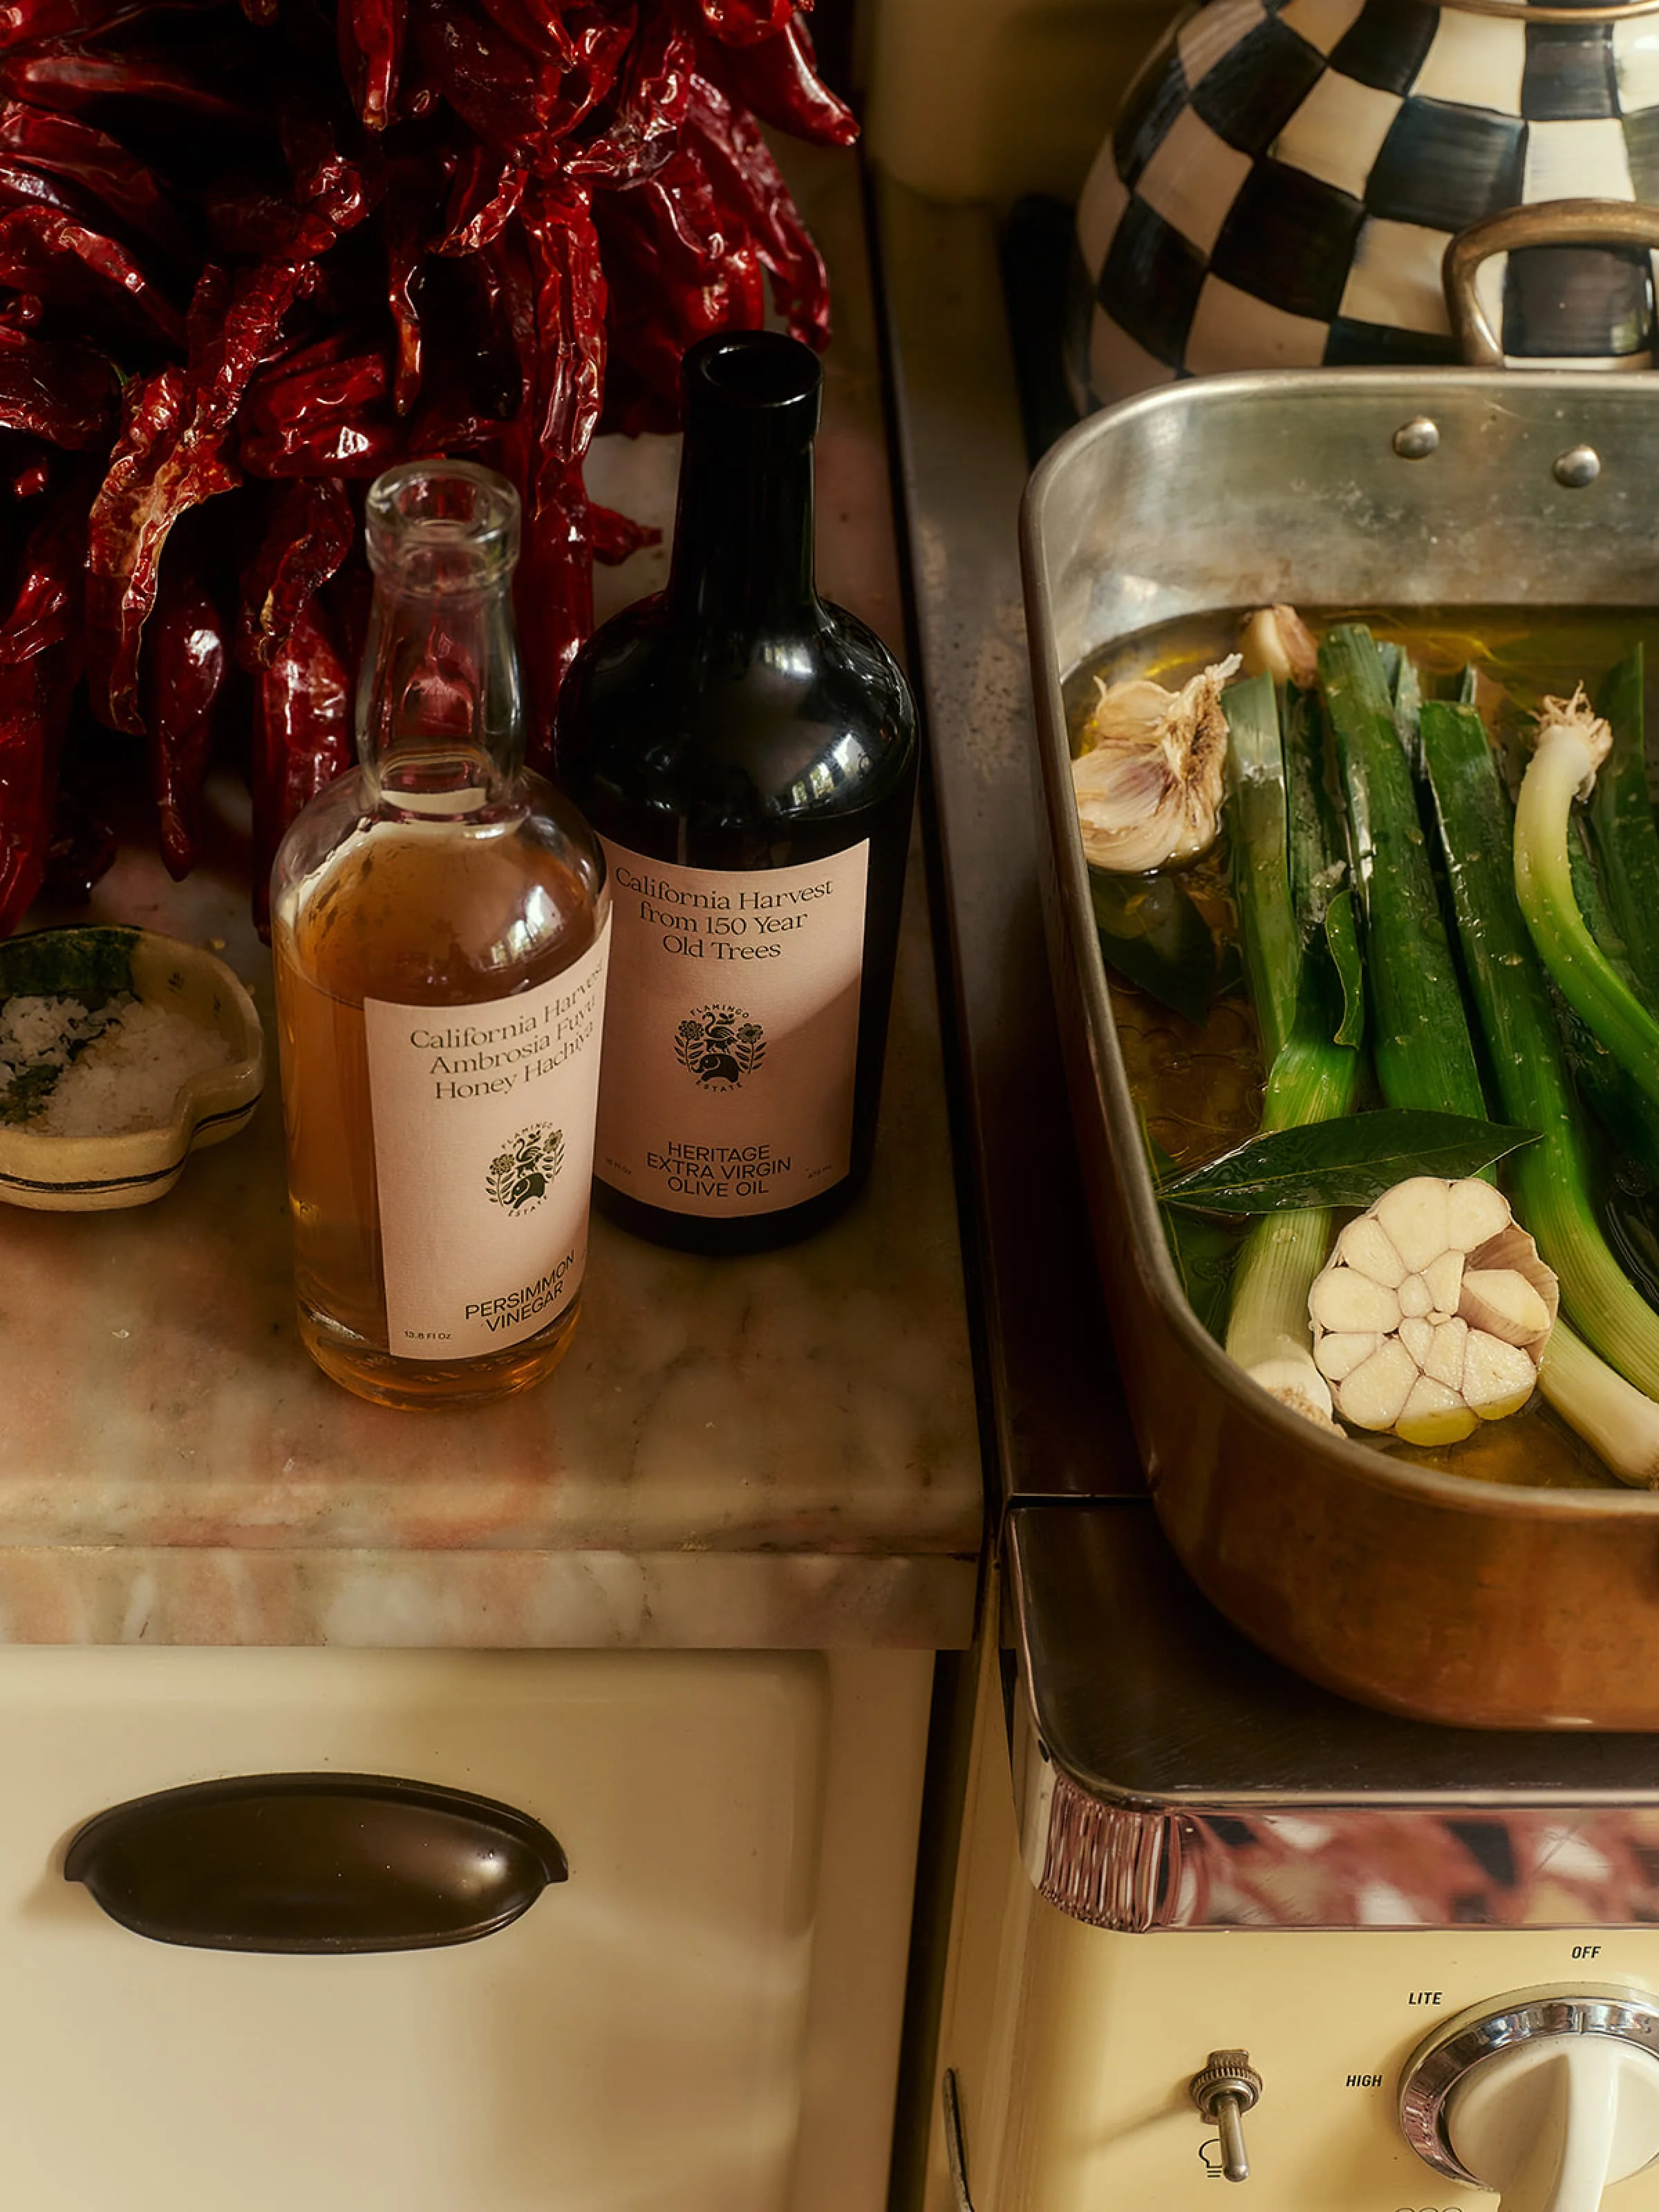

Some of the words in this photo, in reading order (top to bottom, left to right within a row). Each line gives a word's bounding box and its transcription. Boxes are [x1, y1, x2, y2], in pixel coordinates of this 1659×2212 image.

[616, 868, 731, 910] California
[739, 880, 834, 910] Harvest
[640, 901, 697, 932] from
[706, 916, 747, 935] 150
[754, 912, 808, 934] Year
[662, 934, 704, 959] Old
[710, 941, 782, 960] Trees
[409, 1015, 538, 1049] California
[430, 1034, 551, 1075] Ambrosia
[435, 1073, 518, 1100] Honey
[668, 1141, 771, 1163] HERITAGE
[646, 1152, 714, 1179] EXTRA
[720, 1156, 792, 1181] VIRGIN
[667, 1177, 729, 1197] OLIVE
[735, 1180, 770, 1197] OIL
[465, 1248, 574, 1320] PERSIMMON
[485, 1280, 563, 1333] VINEGAR
[1571, 1945, 1602, 1959] OFF
[1407, 1991, 1443, 2006] LITE
[1345, 2074, 1382, 2088] HIGH
